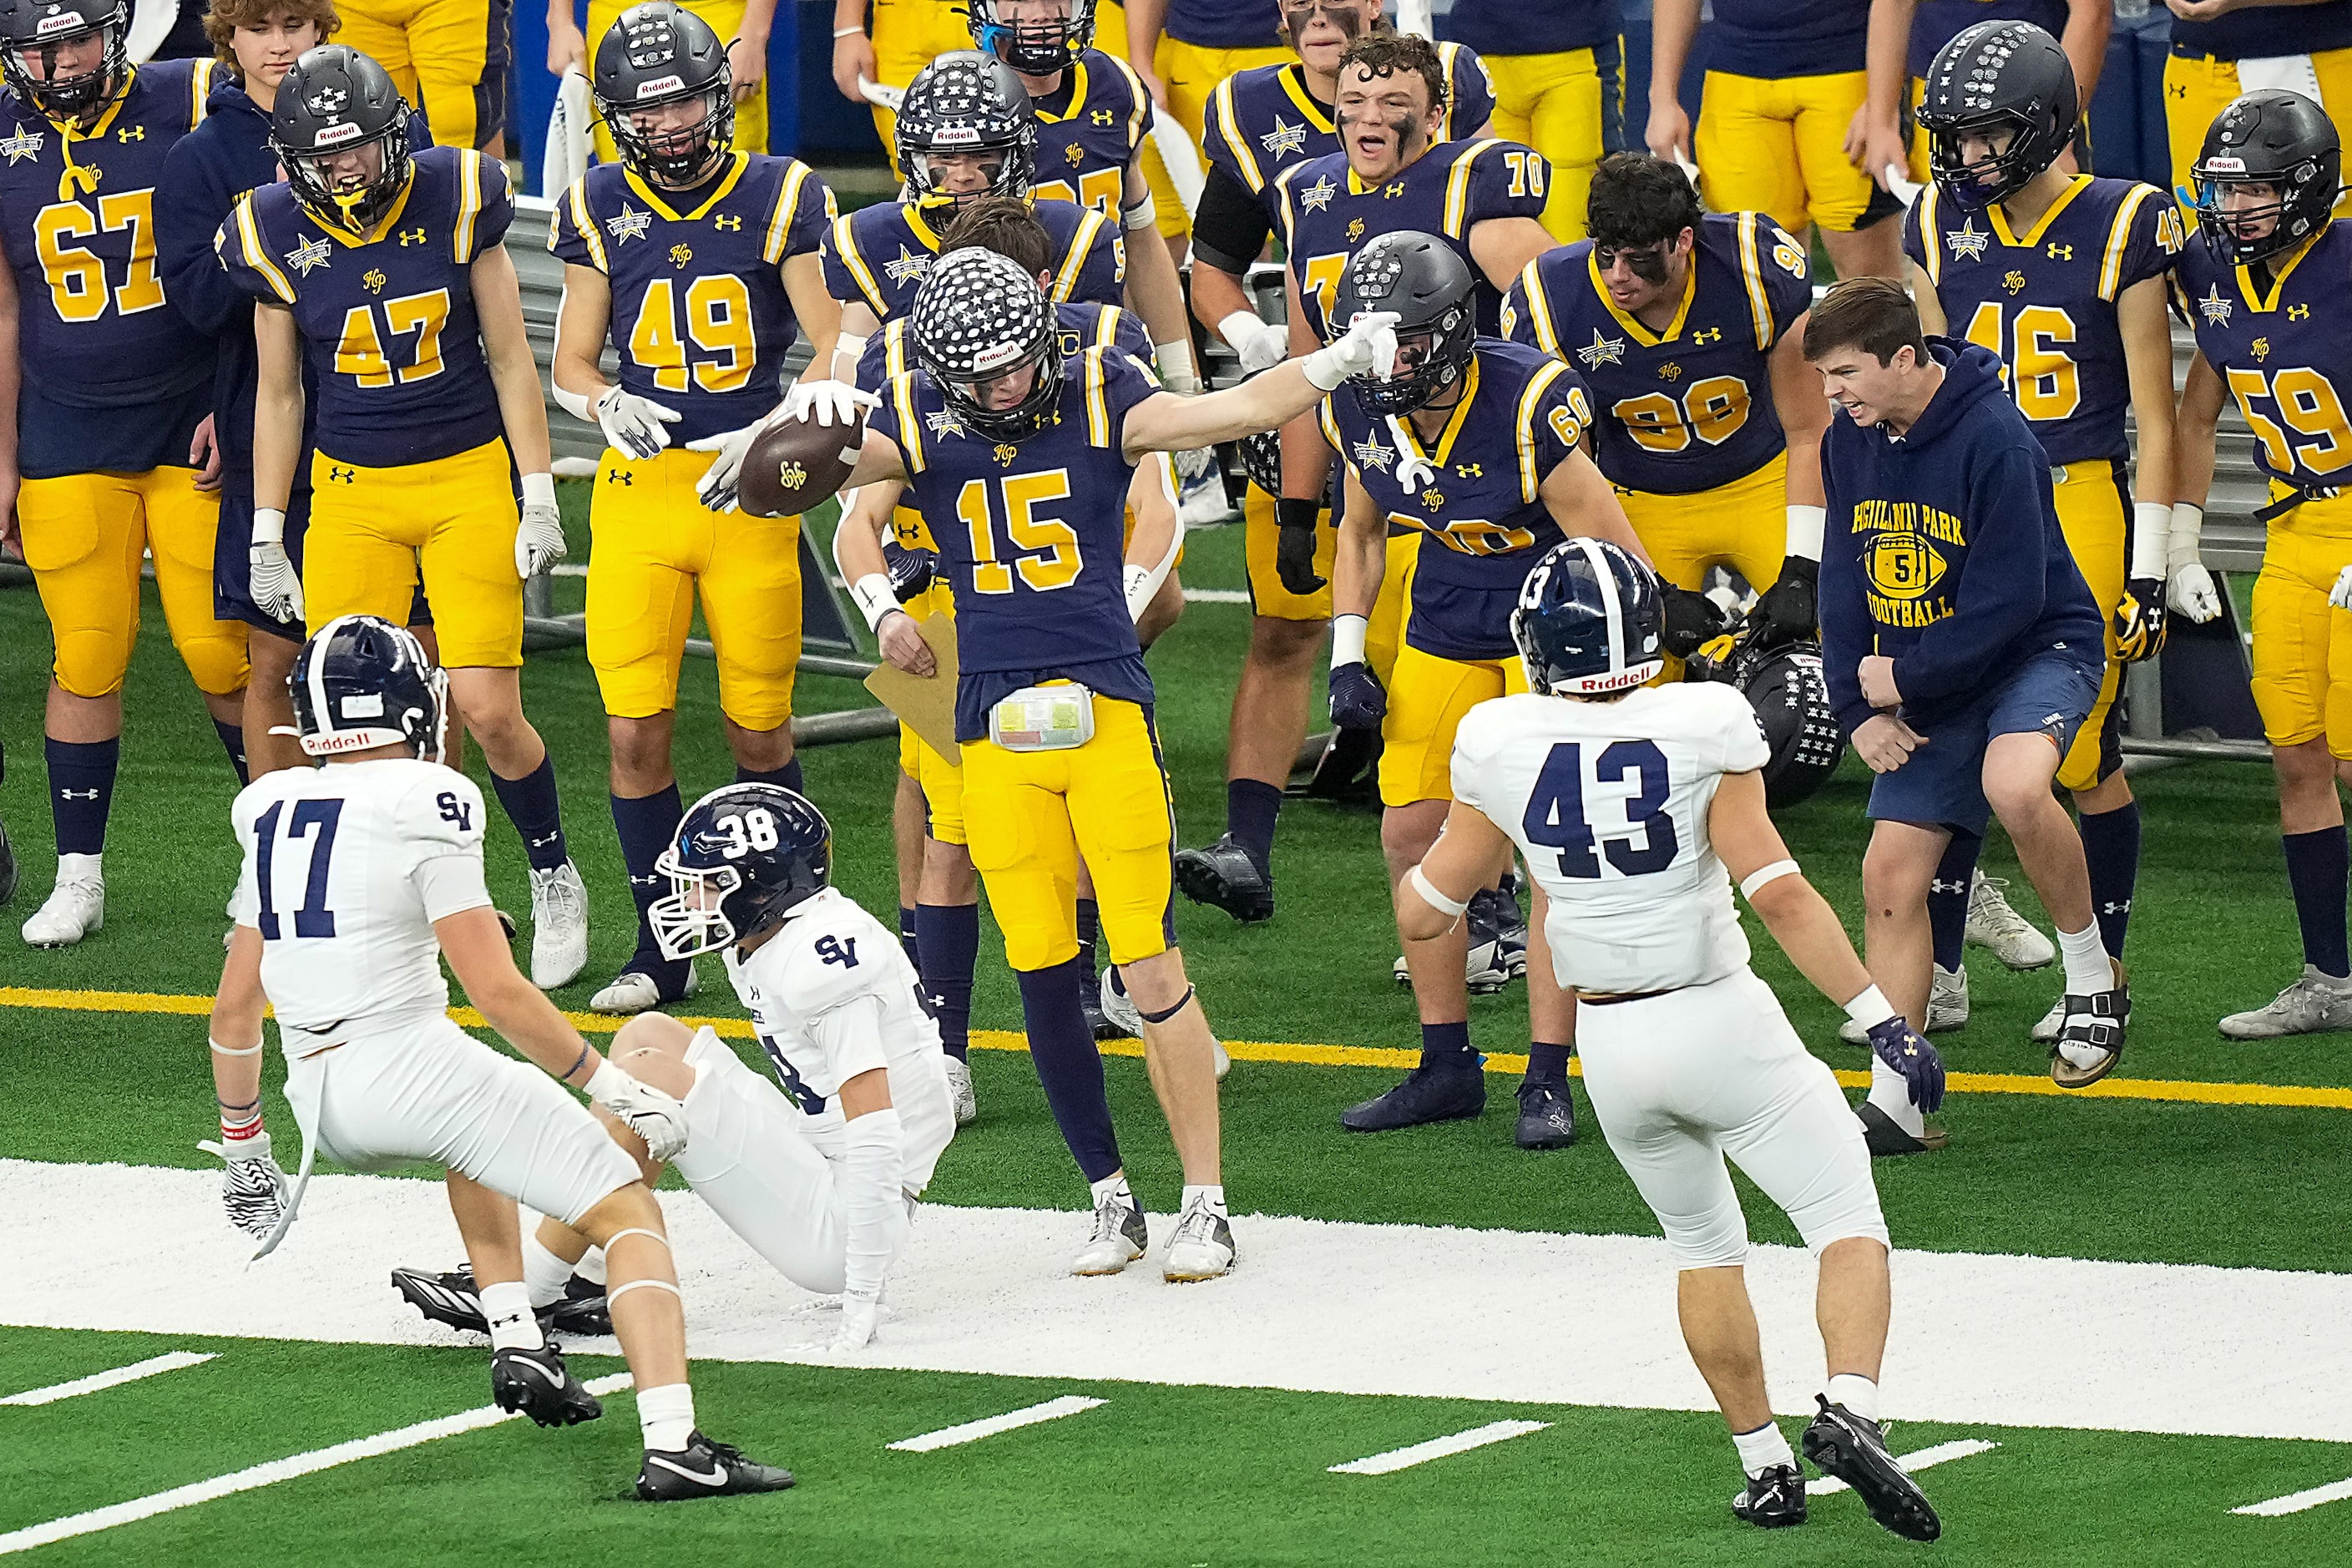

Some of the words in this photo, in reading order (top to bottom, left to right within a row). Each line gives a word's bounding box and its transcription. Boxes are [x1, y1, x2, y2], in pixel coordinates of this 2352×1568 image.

[43, 17, 77, 30] Riddell
[642, 79, 677, 94] Riddell
[319, 127, 355, 141] Riddell
[938, 130, 974, 140] Riddell
[1065, 142, 1085, 169] HP
[2209, 160, 2238, 169] Riddell
[1504, 152, 1545, 198] 70
[1027, 166, 1121, 225] 7
[1344, 218, 1364, 243] HP
[2156, 205, 2184, 255] 46
[33, 186, 166, 323] 67
[669, 242, 694, 269] HP
[362, 267, 387, 295] HP
[2002, 269, 2026, 296] HP
[334, 286, 452, 389] 47
[628, 272, 757, 393] 49
[979, 345, 1014, 364] Riddell
[1964, 301, 2081, 422] 46
[2250, 336, 2270, 363] HP
[1658, 361, 1682, 382] HP
[1548, 387, 1594, 448] 60
[2226, 366, 2352, 476] 59
[993, 443, 1017, 468] HP
[1421, 487, 1444, 513] HP
[956, 467, 1084, 595] 15
[1922, 503, 1966, 547] PARK
[1894, 554, 1909, 582] 5
[1581, 666, 1651, 690] Riddell
[307, 733, 370, 751] Riddell
[436, 792, 473, 832] SV
[1522, 739, 1680, 879] 43
[716, 807, 780, 860] 38
[253, 797, 346, 941] 17
[814, 933, 861, 970] SV
